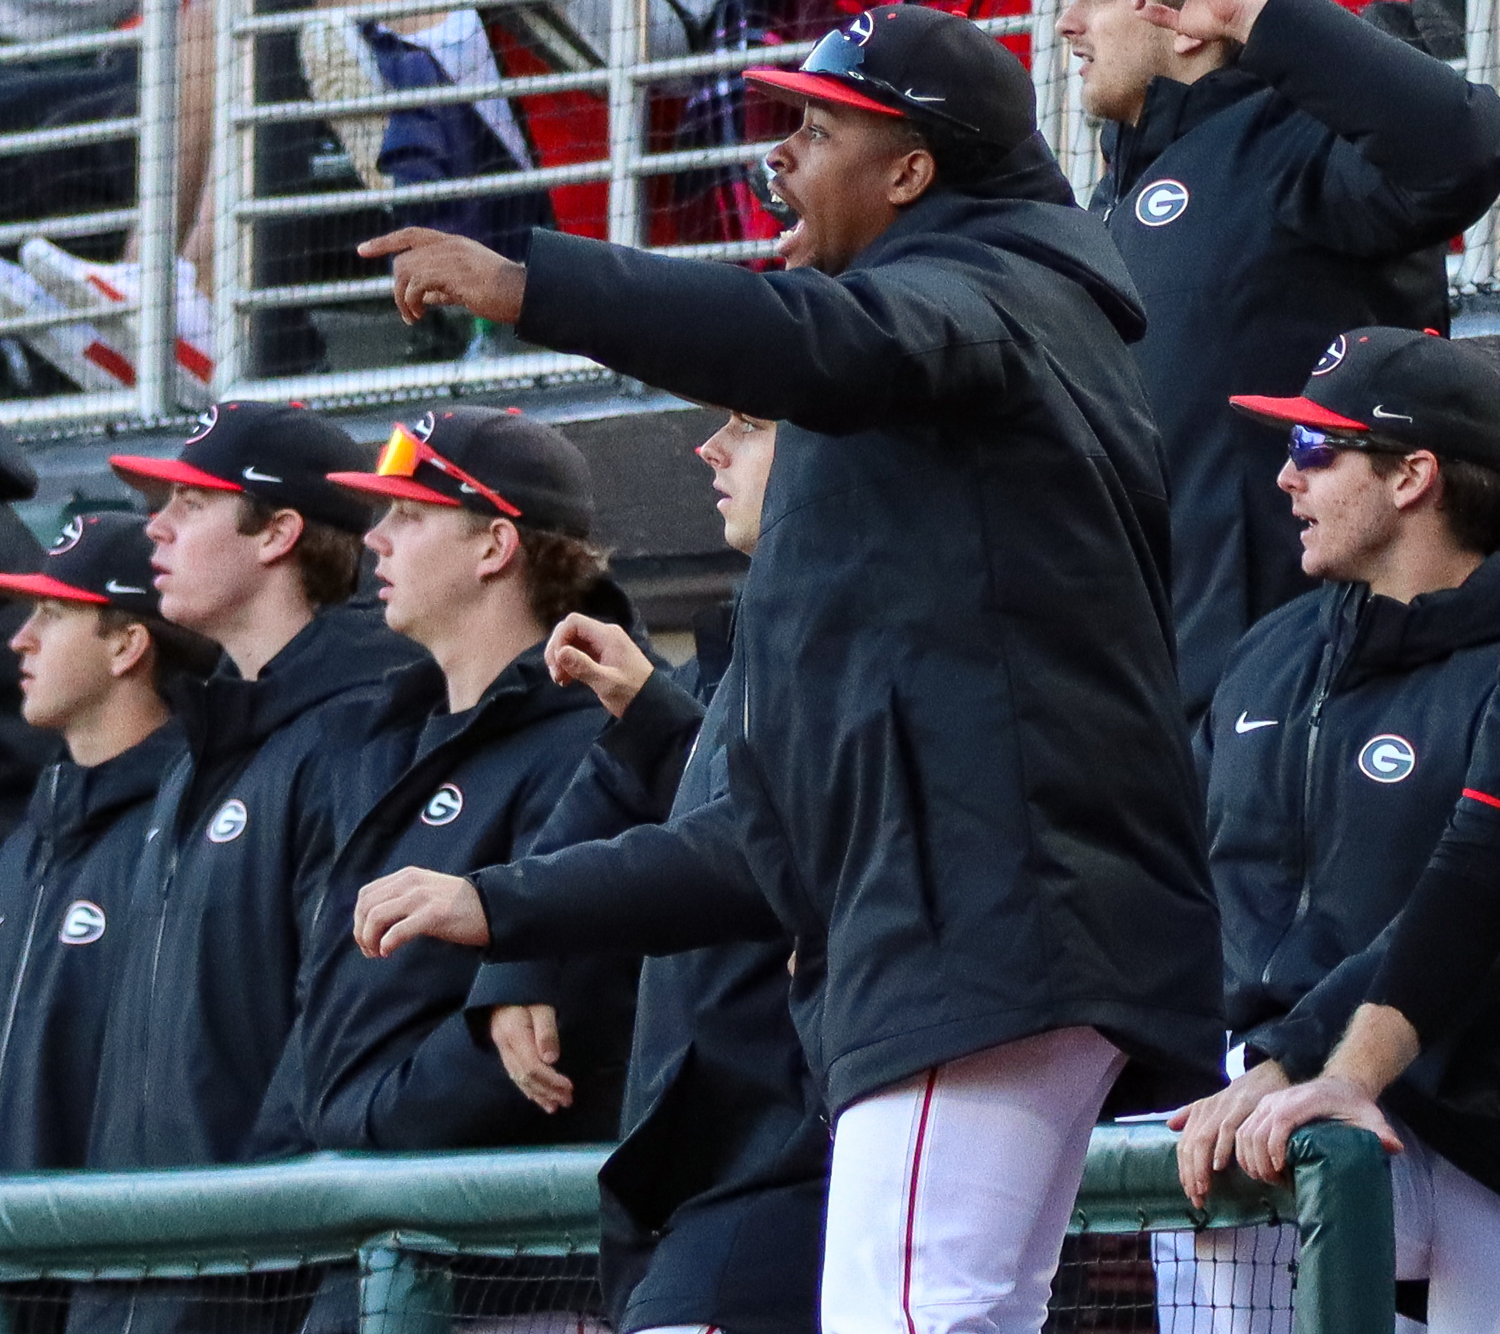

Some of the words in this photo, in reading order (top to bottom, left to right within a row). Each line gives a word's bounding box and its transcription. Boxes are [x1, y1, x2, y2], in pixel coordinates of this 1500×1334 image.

[1135, 179, 1190, 227] G
[1358, 733, 1415, 784] G
[205, 798, 249, 844] G
[420, 781, 463, 827] G
[56, 898, 105, 945] G
